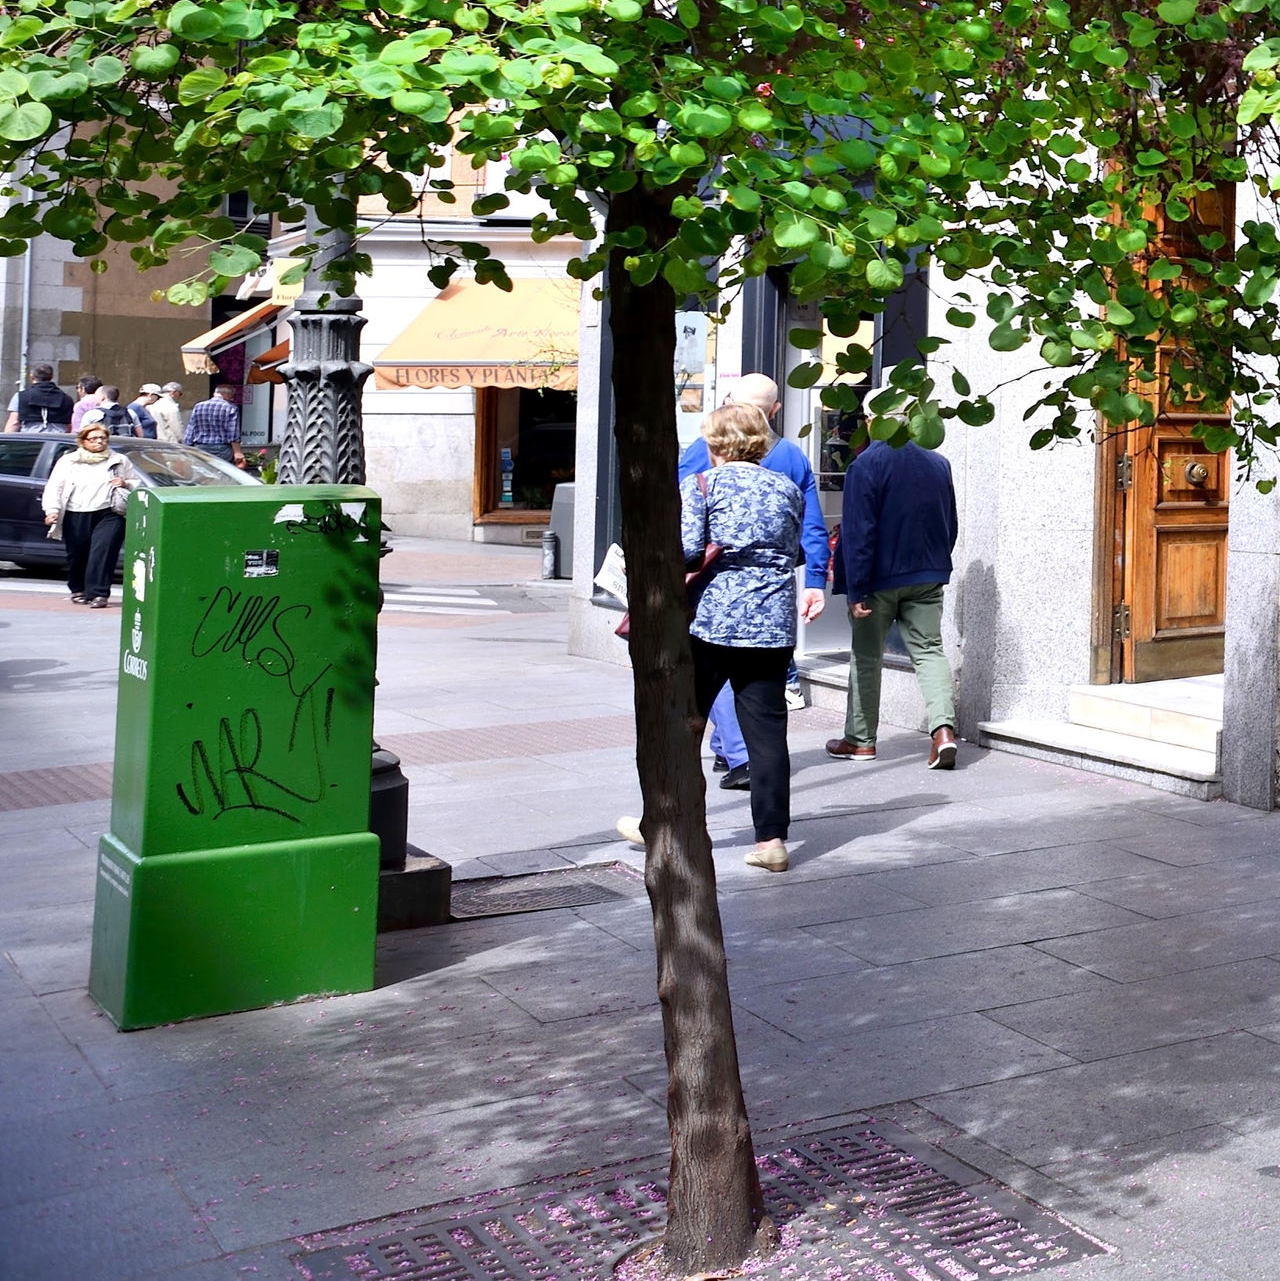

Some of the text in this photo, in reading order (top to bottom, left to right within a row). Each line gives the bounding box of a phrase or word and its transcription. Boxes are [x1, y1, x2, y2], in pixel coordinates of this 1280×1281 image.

[491, 327, 529, 338] Arte
[395, 368, 561, 385] FLORES Y PLANTAS
[123, 649, 148, 682] CORREOS
